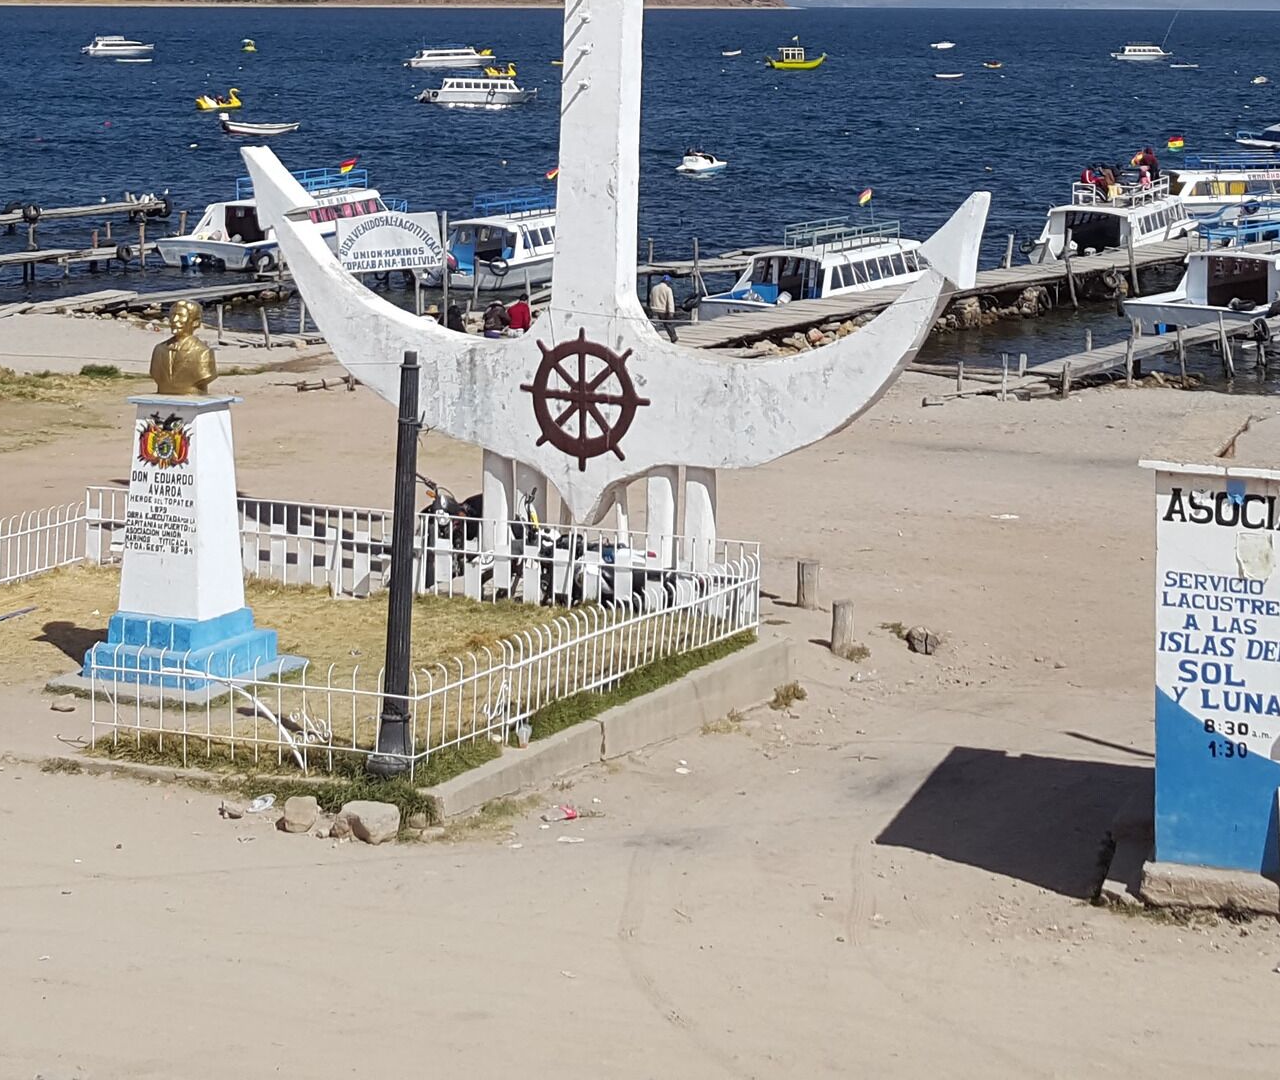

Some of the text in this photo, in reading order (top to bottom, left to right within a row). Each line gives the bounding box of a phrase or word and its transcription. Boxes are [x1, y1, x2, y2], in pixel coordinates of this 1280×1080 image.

[132, 470, 193, 485] DON EDUARDO
[159, 537, 188, 547] TITICACA
[1164, 571, 1265, 596] SERVICIO
[1162, 591, 1280, 617] LACUSTRE
[1182, 613, 1258, 636] A LAS
[1158, 631, 1237, 658] ISLAS
[1177, 658, 1246, 688] SOL
[1172, 686, 1189, 704] Y
[1203, 718, 1273, 740] 8:30 a.m.
[1207, 740, 1249, 759] 1:30
